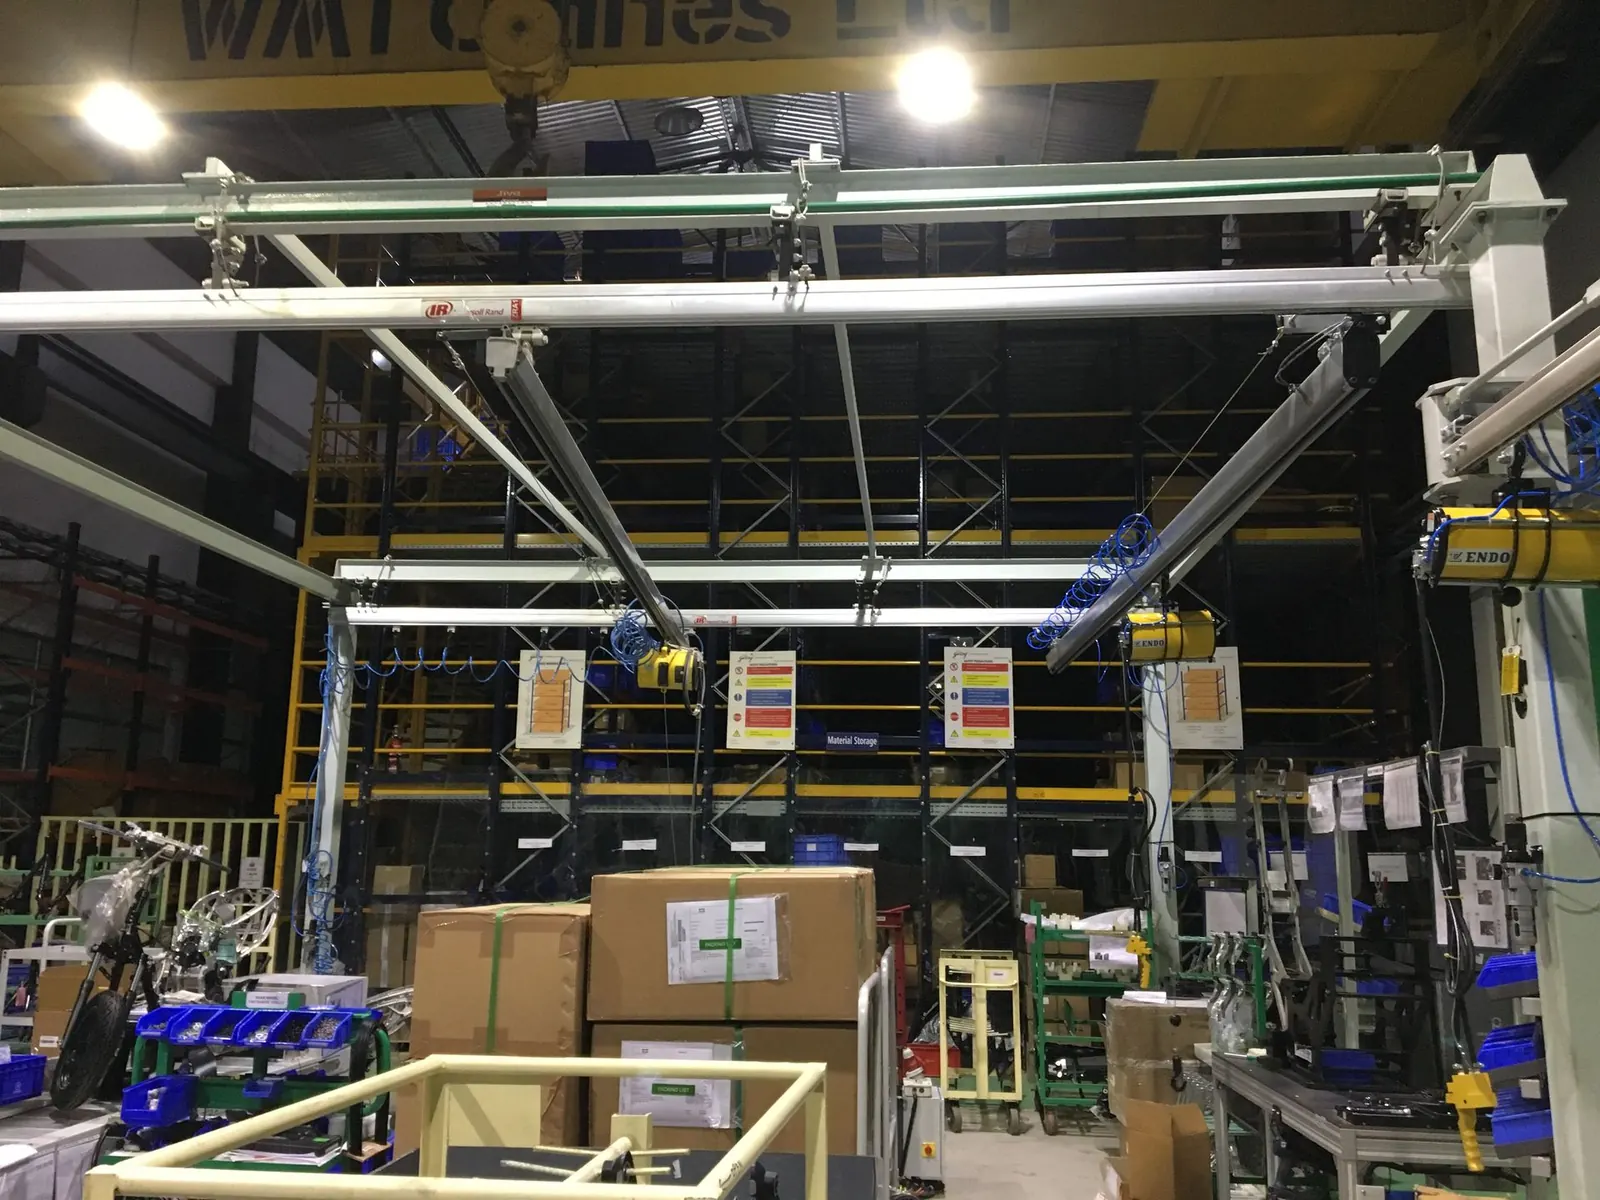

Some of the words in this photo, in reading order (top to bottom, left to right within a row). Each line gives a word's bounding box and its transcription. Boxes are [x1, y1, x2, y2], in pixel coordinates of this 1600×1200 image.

[485, 308, 504, 316] Rand
[1465, 551, 1511, 563] ENDO
[1142, 639, 1165, 647] ENDO
[827, 735, 853, 745] Material
[853, 736, 878, 748] Storage
